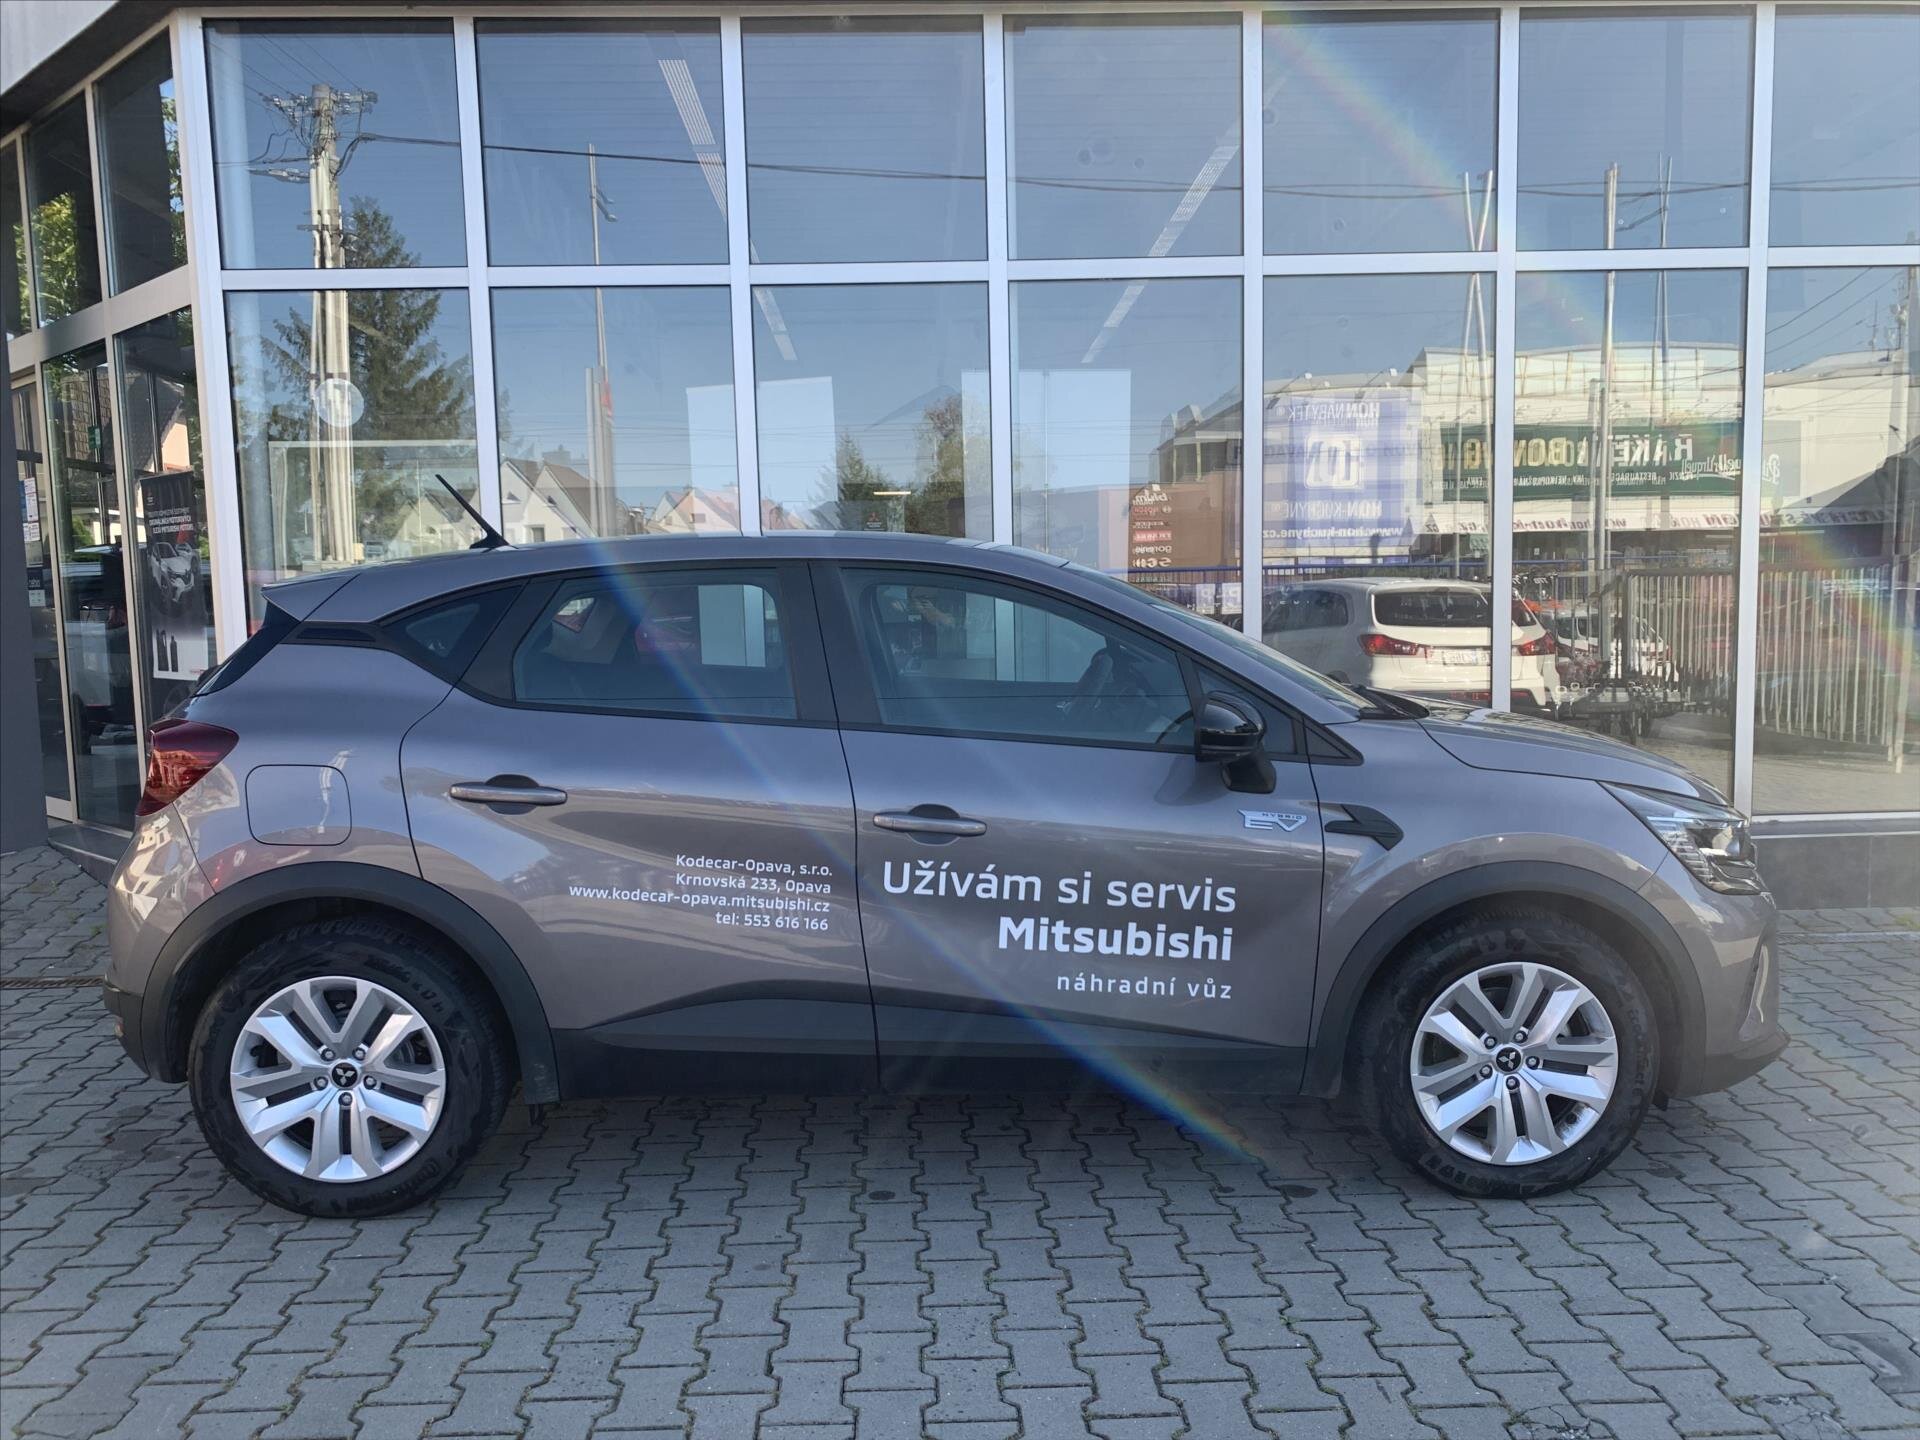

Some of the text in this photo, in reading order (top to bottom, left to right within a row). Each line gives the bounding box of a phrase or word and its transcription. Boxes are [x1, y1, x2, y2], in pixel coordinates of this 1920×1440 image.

[676, 854, 833, 876] Kodecar-Opava, s.r.o.
[676, 873, 832, 895] Krnovská 233, Opava
[883, 859, 1237, 914] Užívám si servis
[569, 885, 831, 912] www.kodecar-opava.mitsubishi.cz
[715, 911, 829, 931] tel: 553 616 166
[998, 916, 1233, 962] Mitsubishi
[1057, 972, 1233, 1000] náhradní vůz
